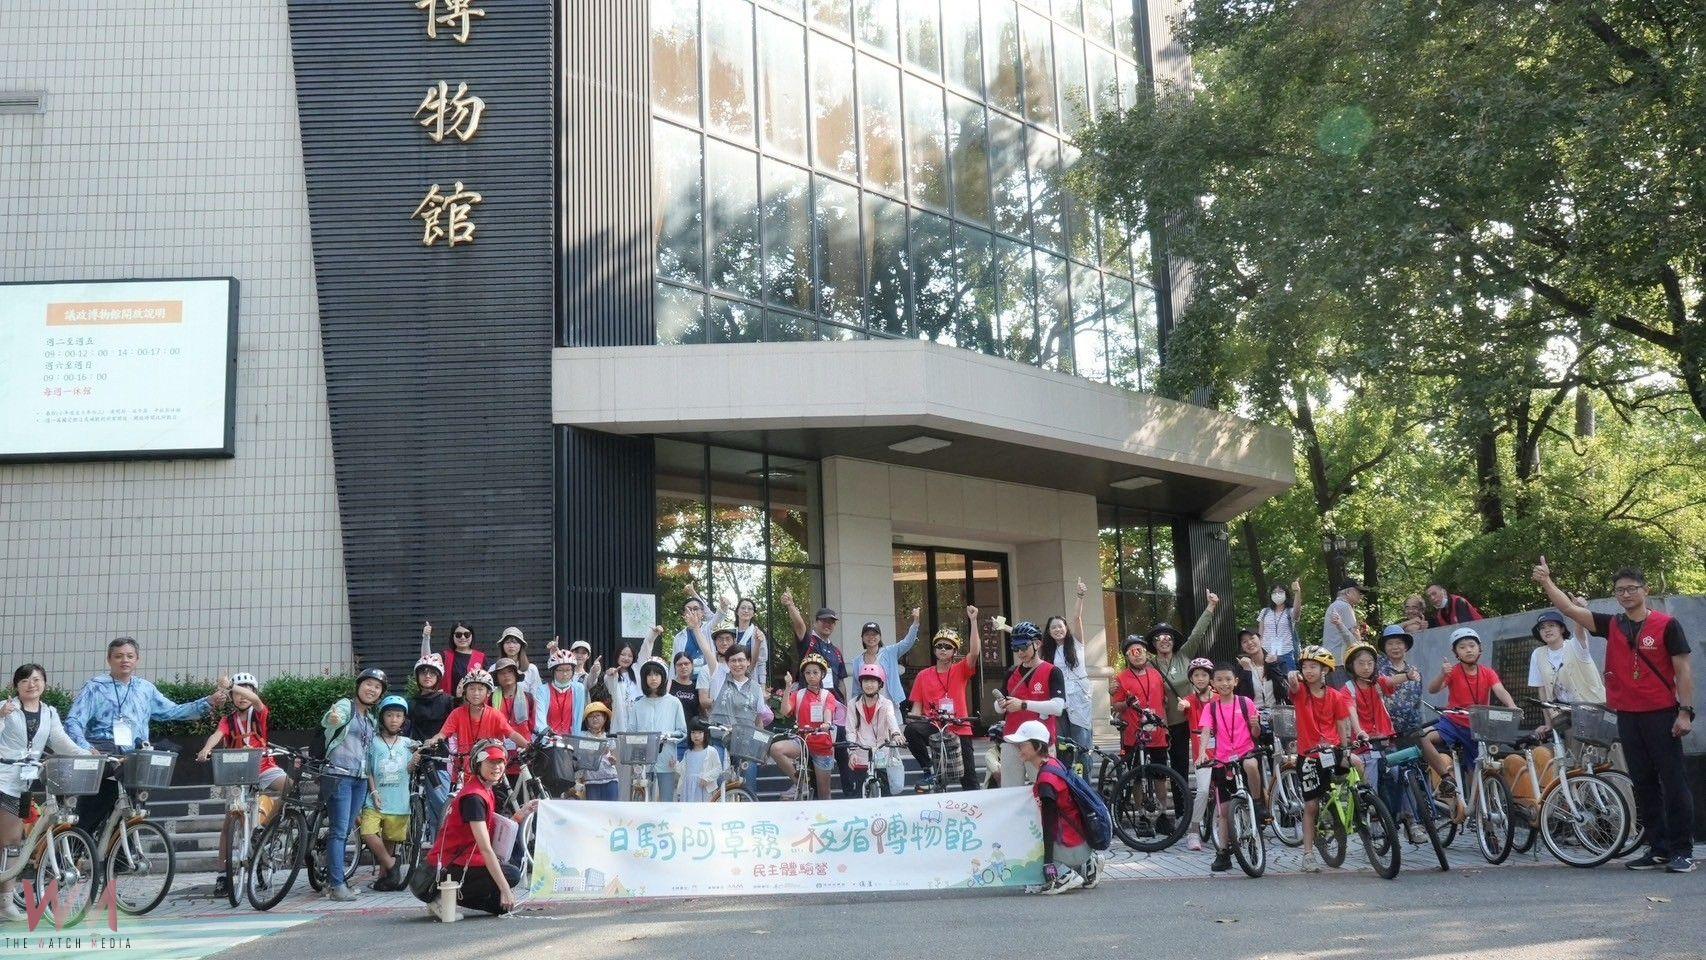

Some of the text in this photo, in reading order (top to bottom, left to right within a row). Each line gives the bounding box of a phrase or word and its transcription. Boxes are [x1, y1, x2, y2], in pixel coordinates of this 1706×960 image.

[609, 819, 784, 861] 日騎阿罩霧
